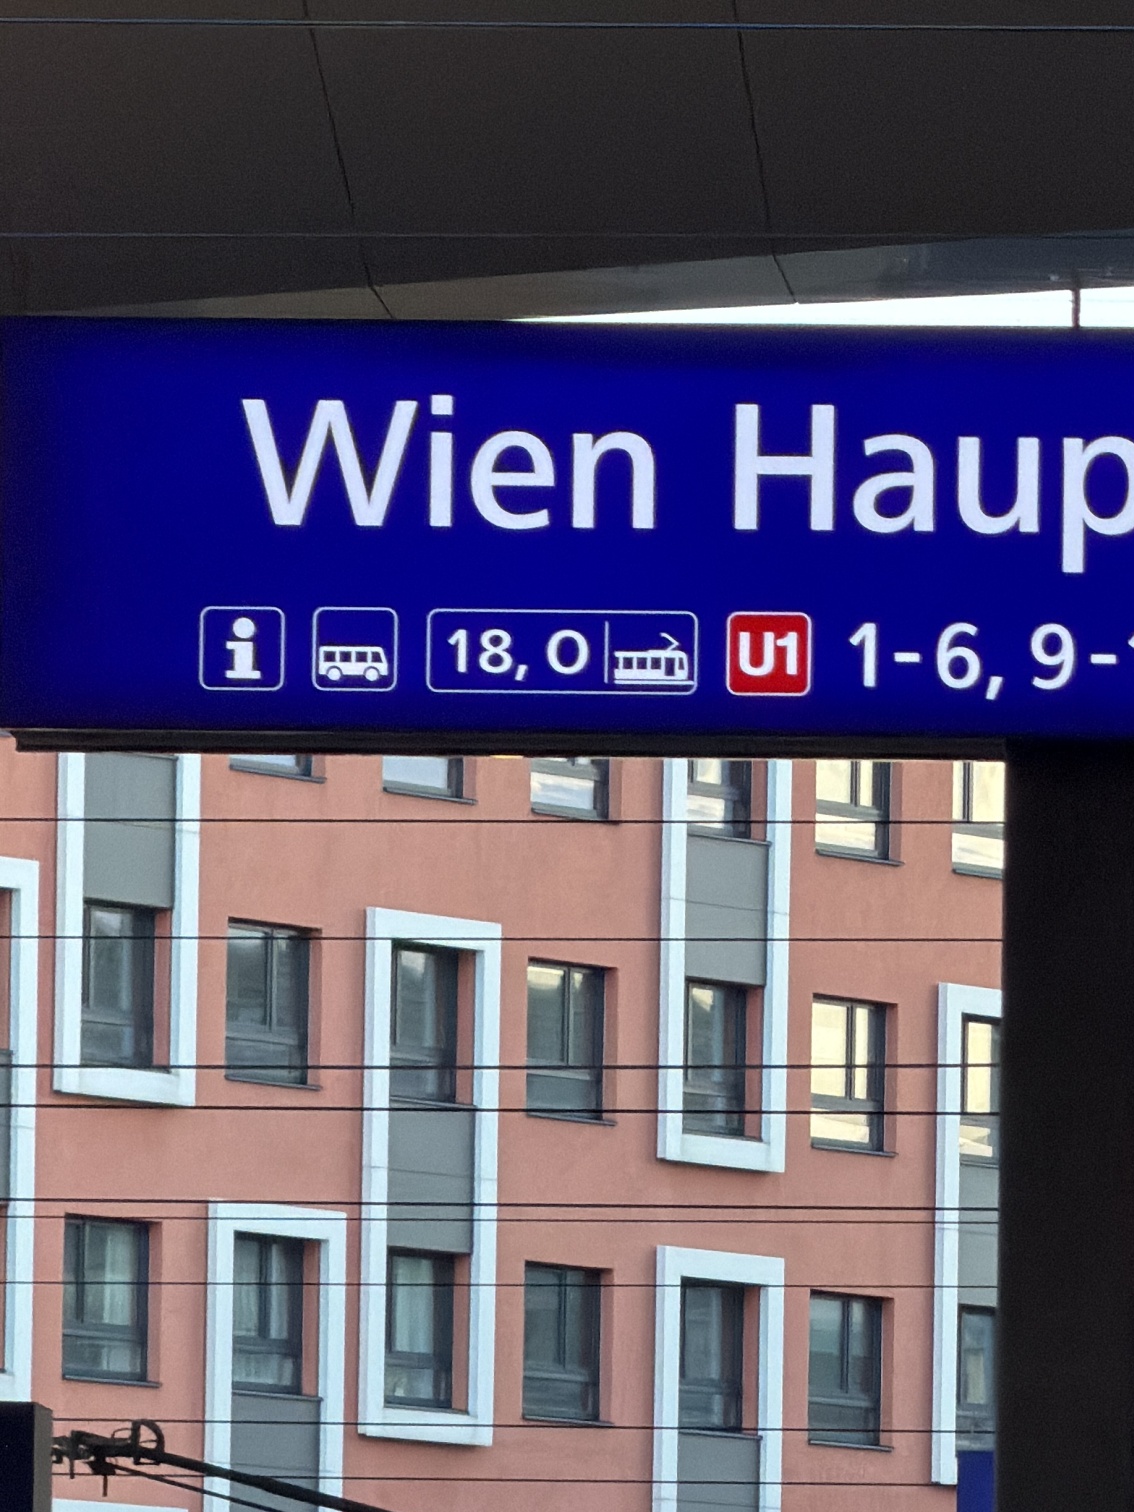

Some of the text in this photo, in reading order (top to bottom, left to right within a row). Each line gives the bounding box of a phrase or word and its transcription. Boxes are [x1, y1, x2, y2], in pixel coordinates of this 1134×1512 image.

[241, 394, 656, 530] Wien
[446, 628, 528, 681] 18,
[738, 631, 799, 676] U1
[849, 622, 1004, 700] 1-6,
